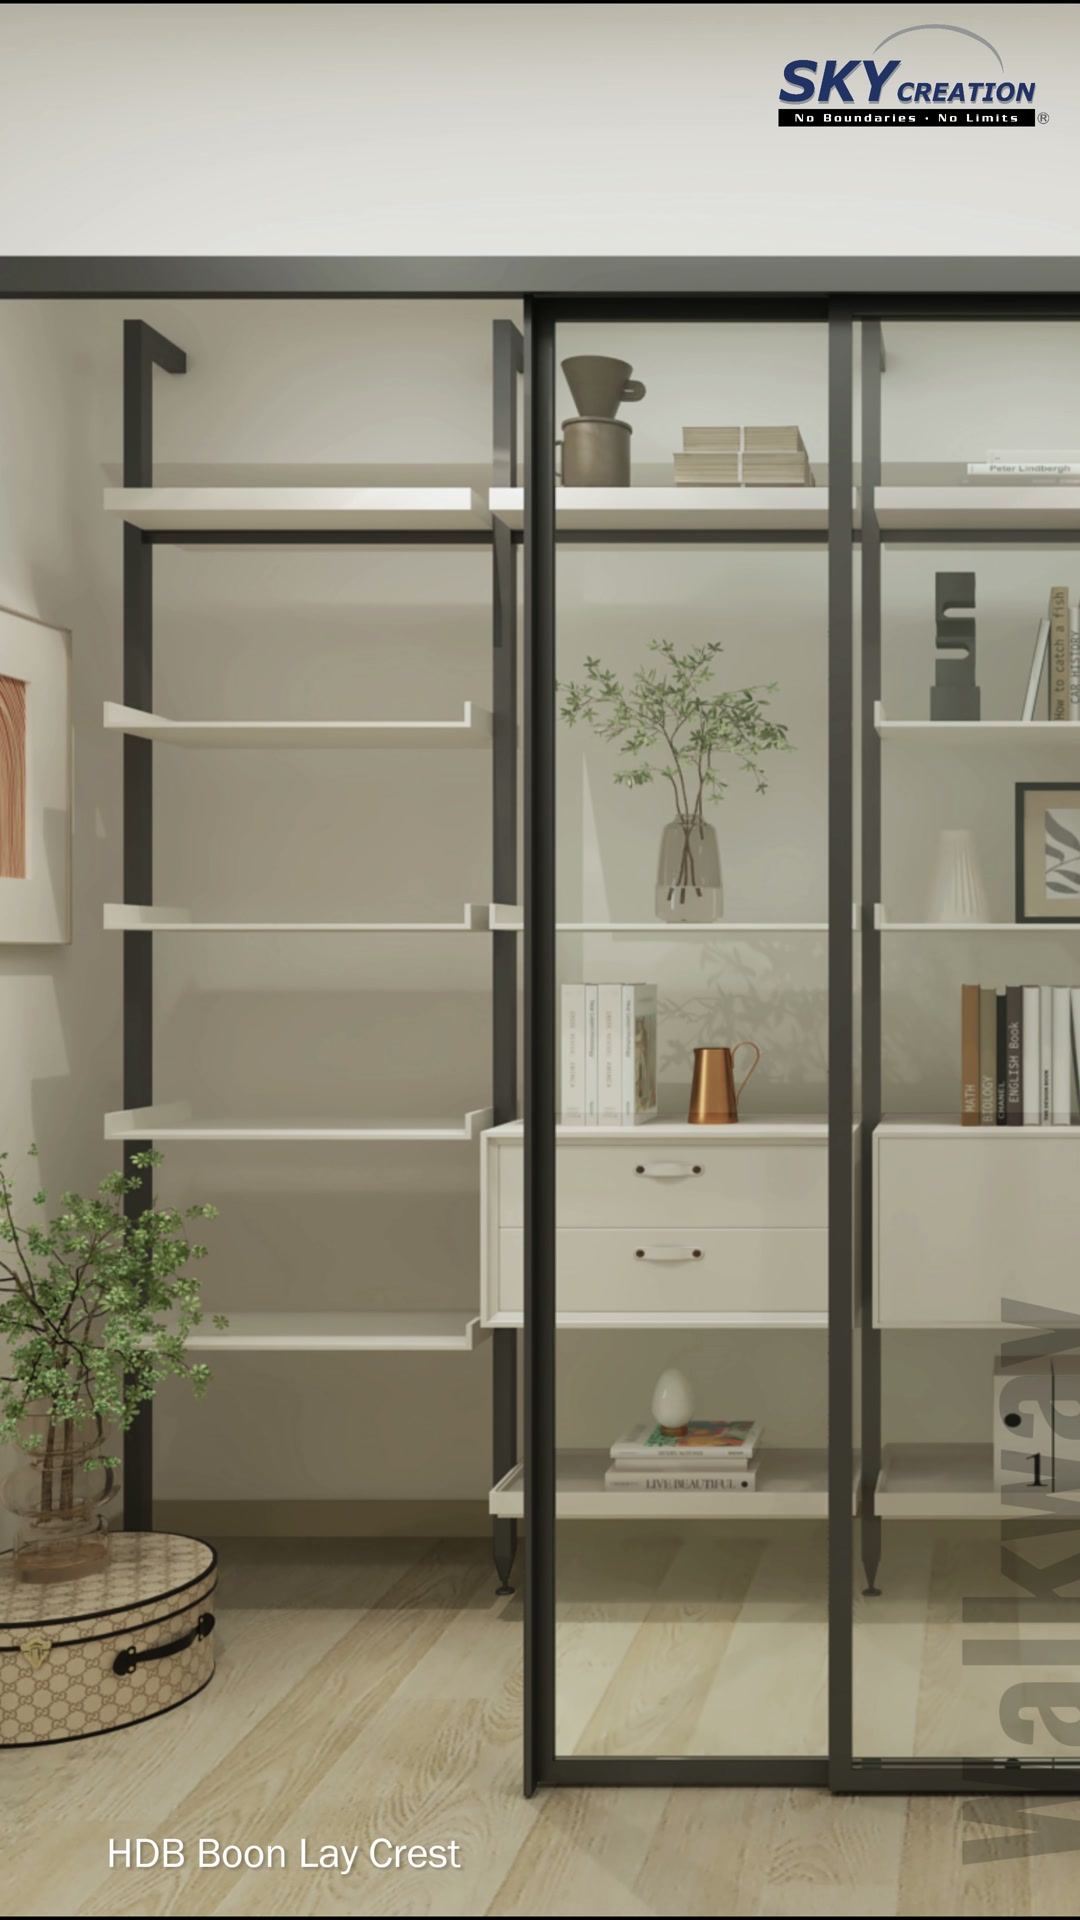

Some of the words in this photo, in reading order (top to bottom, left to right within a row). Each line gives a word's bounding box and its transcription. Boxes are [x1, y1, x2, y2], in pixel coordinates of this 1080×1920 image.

[989, 464, 1016, 473] Peter
[1018, 464, 1071, 474] Lindbergh
[1053, 591, 1065, 618] fish
[1054, 639, 1065, 673] catch
[1070, 631, 1080, 681] HISTORY
[1055, 679, 1065, 692] to
[1070, 685, 1080, 705] CAR
[1054, 699, 1065, 720] How
[1009, 1022, 1019, 1049] Book
[1008, 1055, 1019, 1103] ENGLISH
[965, 1084, 976, 1113] MATH
[982, 1075, 993, 1122] BIOLOGY
[1026, 1452, 1048, 1487] 1
[645, 1479, 673, 1490] LIVE
[674, 1479, 737, 1490] BEAUTIFUL
